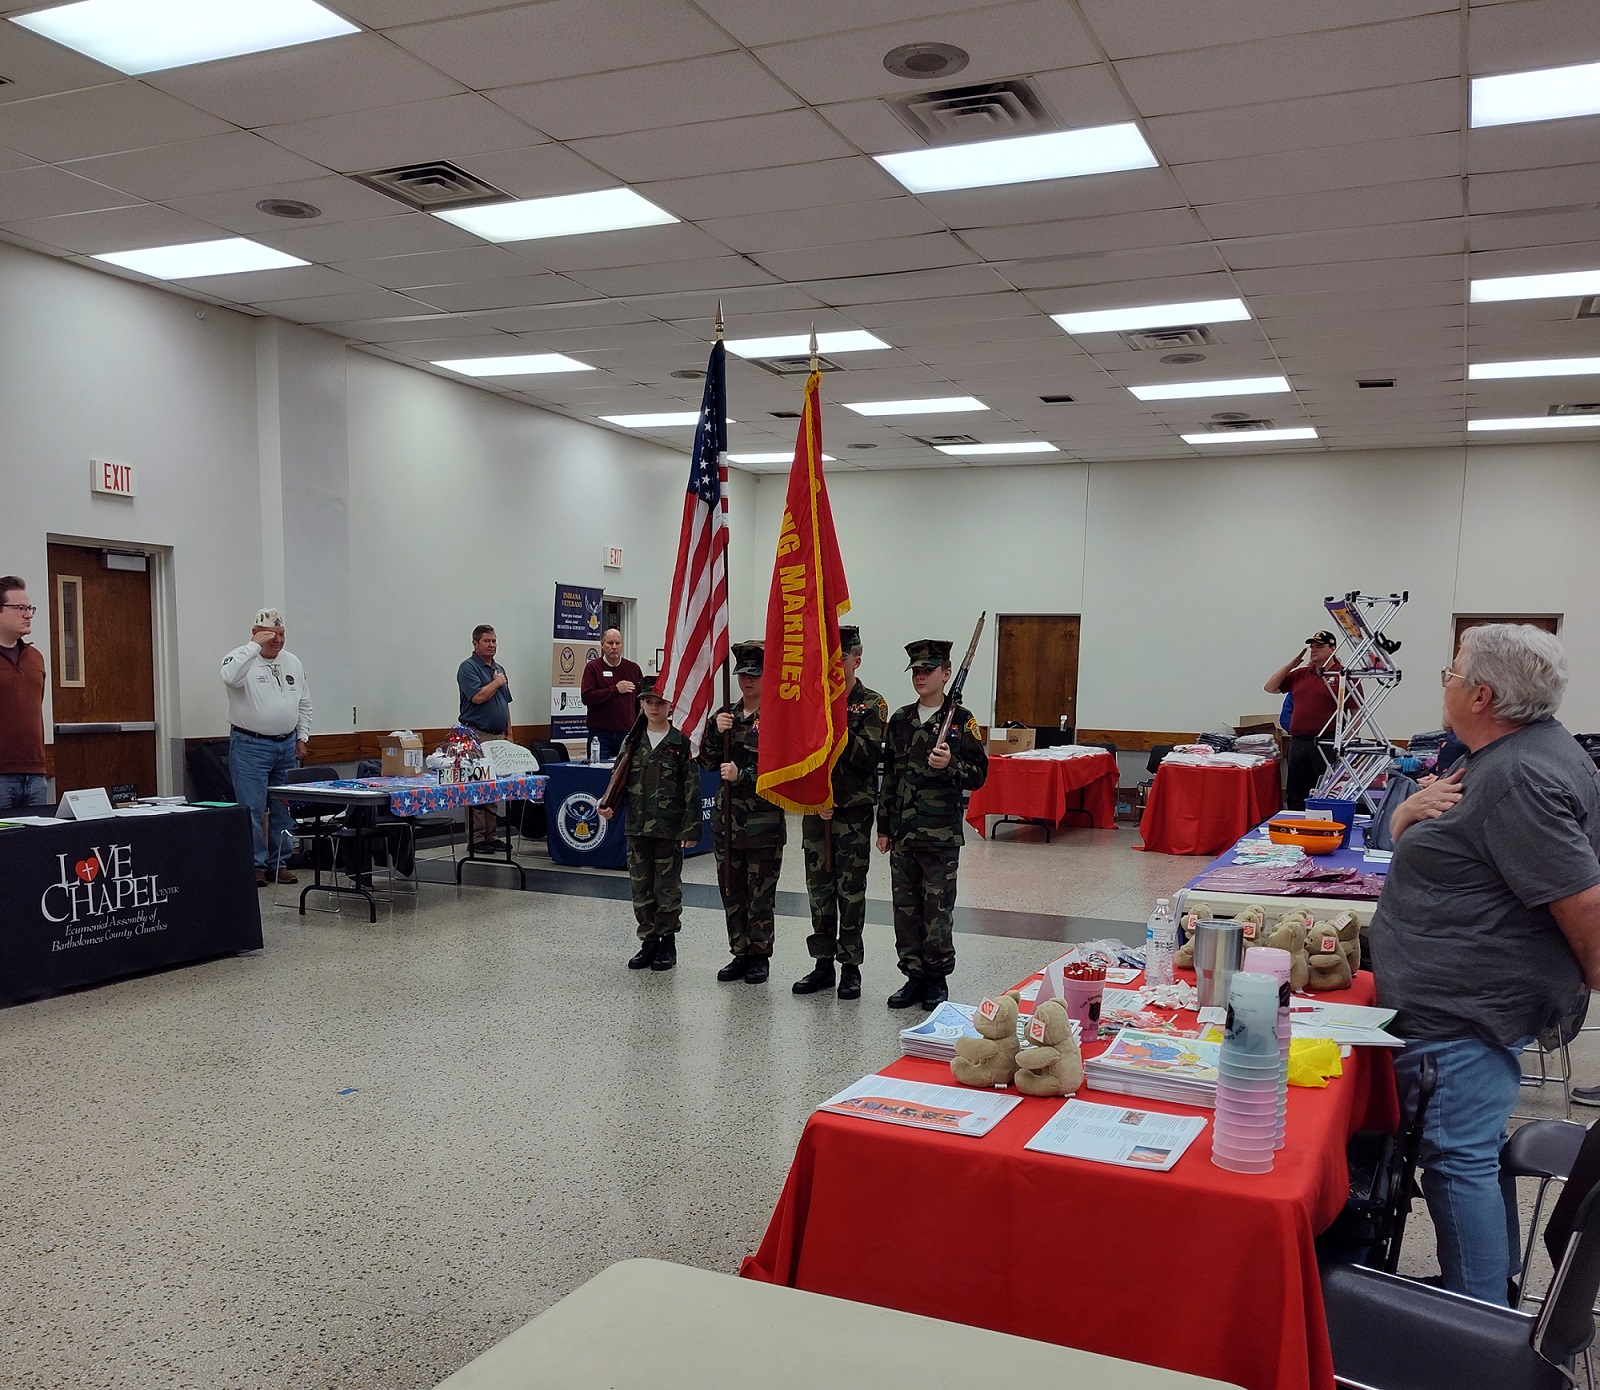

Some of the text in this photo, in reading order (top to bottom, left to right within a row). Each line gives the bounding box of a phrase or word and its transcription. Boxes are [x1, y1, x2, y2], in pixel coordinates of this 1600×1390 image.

[104, 462, 131, 493] EXIT
[610, 547, 622, 566] EXIT
[779, 563, 807, 702] MARINES
[702, 809, 711, 821] NS
[41, 874, 168, 923] CHAPEL
[156, 886, 180, 897] CENTER
[108, 909, 149, 928] Assembly
[148, 907, 158, 924] of
[104, 928, 133, 941] County
[134, 919, 168, 936] Churches
